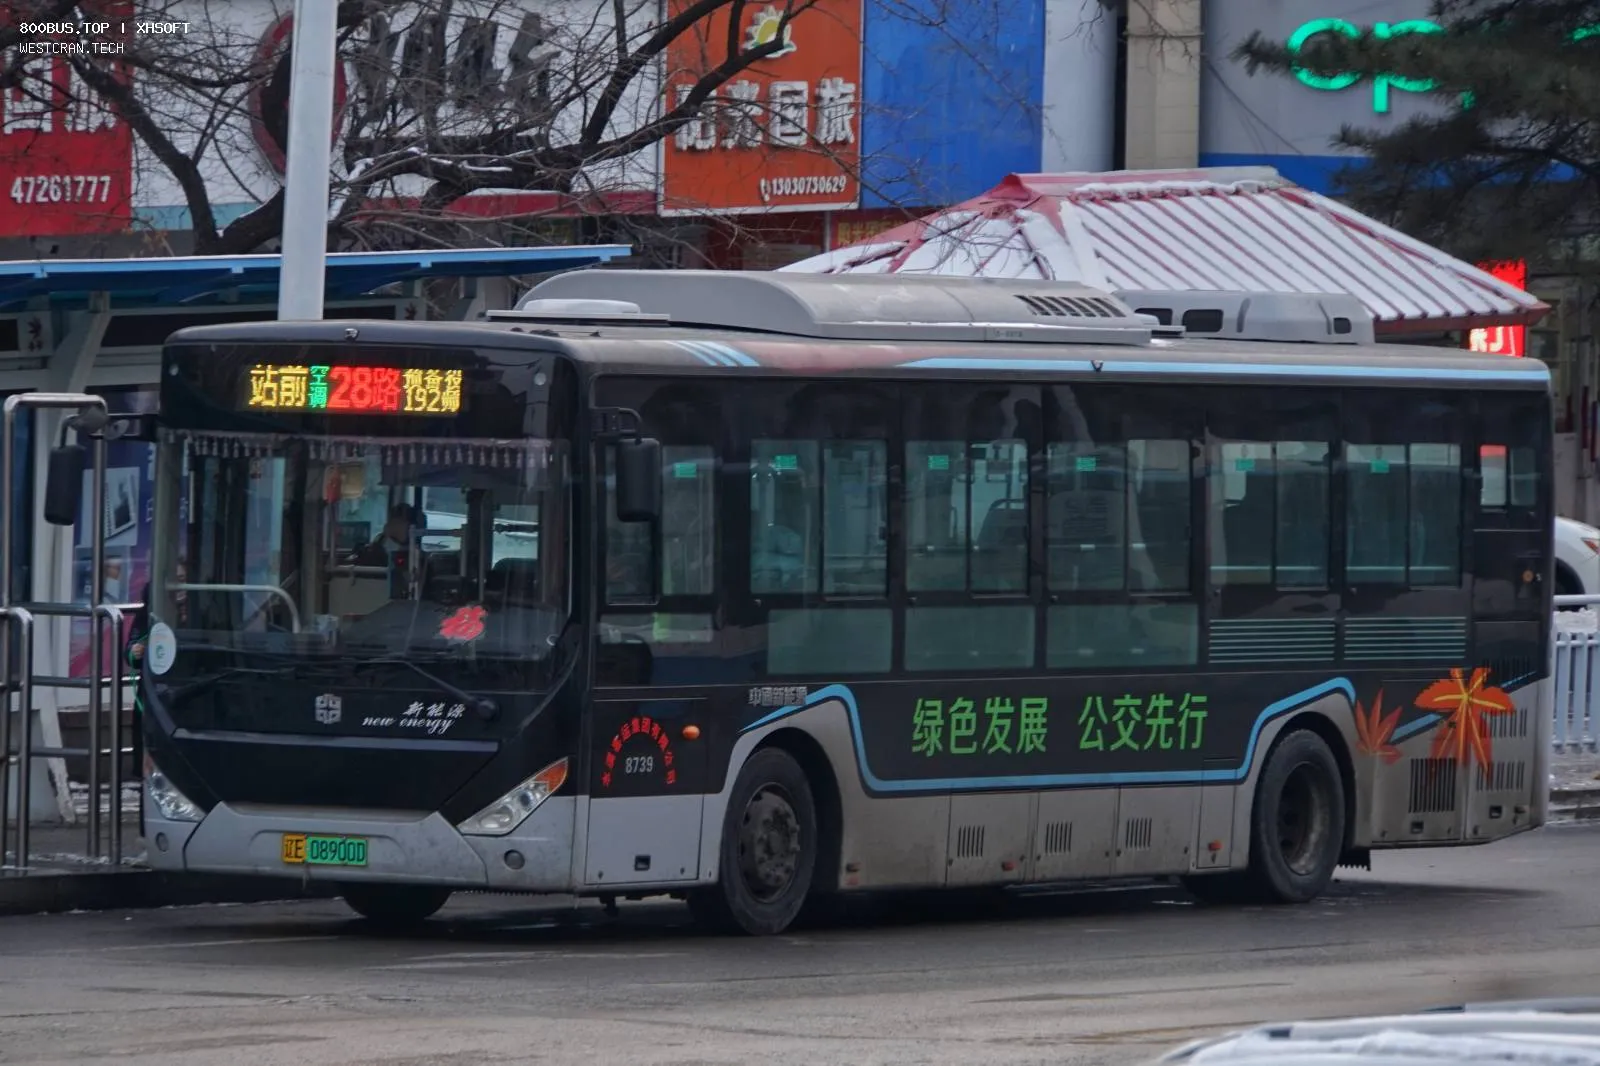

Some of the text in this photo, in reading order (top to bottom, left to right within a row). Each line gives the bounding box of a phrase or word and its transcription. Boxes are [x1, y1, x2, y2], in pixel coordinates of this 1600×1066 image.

[10, 175, 112, 203] 47261777
[248, 364, 309, 407] 站前
[308, 365, 330, 408] 空调
[327, 366, 401, 410] 28路
[362, 715, 456, 735] new energy
[402, 701, 466, 718] 新能源
[911, 693, 1208, 757] 绿色发展 公交先行
[625, 756, 654, 774] 8739
